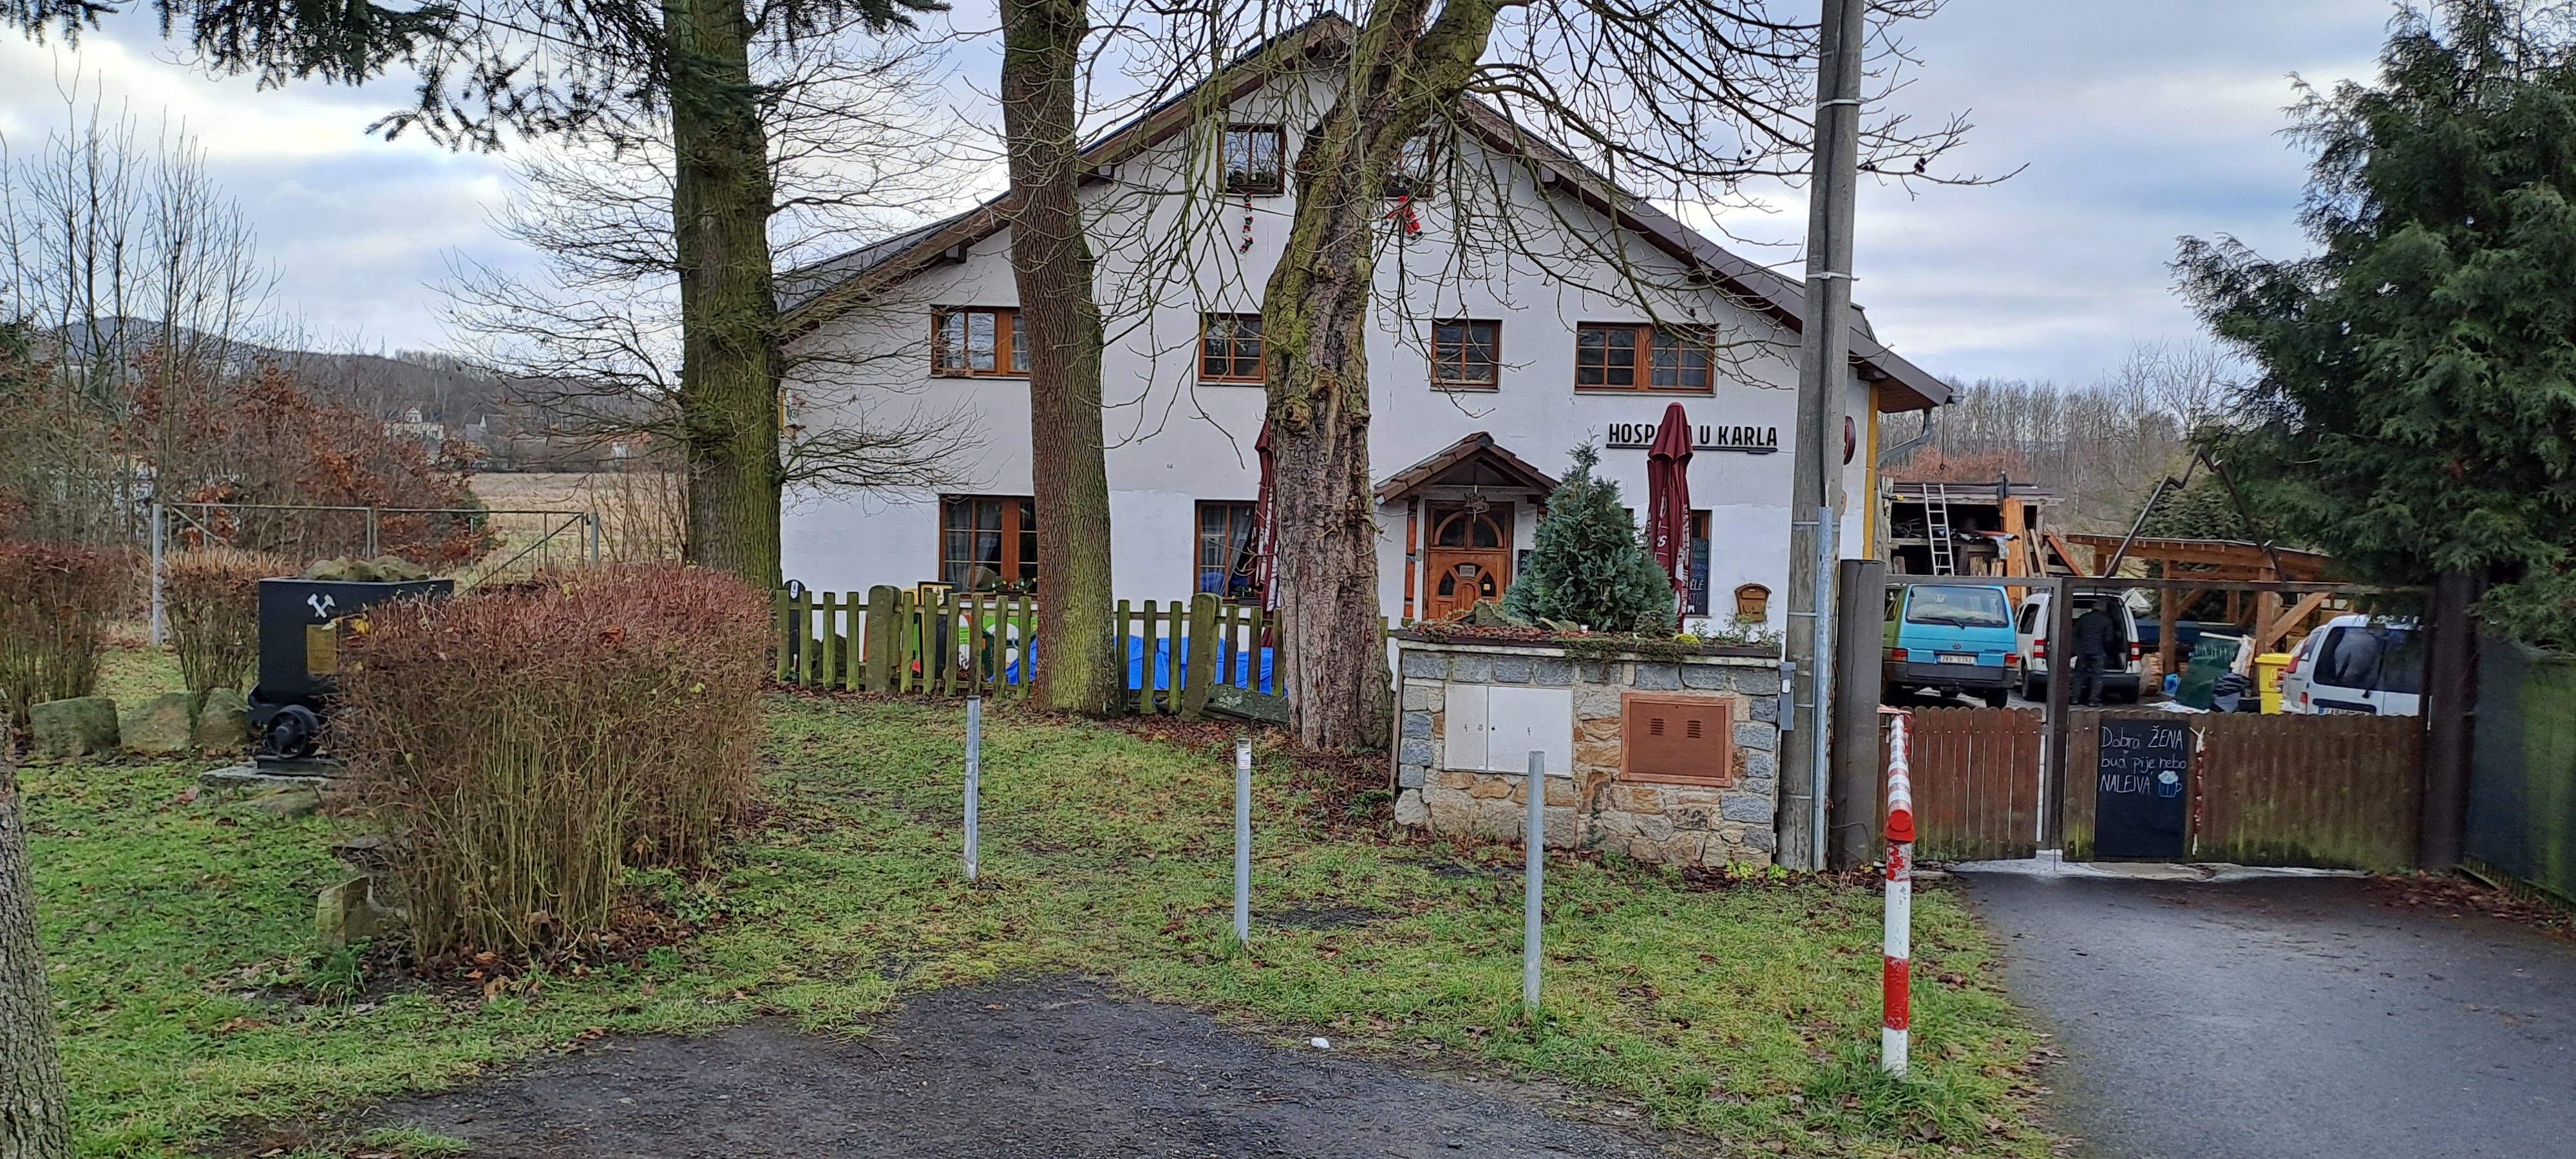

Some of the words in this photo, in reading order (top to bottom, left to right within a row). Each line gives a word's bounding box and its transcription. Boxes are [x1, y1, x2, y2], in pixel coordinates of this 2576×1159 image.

[1700, 426, 1710, 445] U
[1718, 426, 1777, 446] KARLA
[2147, 724, 2183, 750] ŽENA
[2159, 754, 2186, 769] nebo
